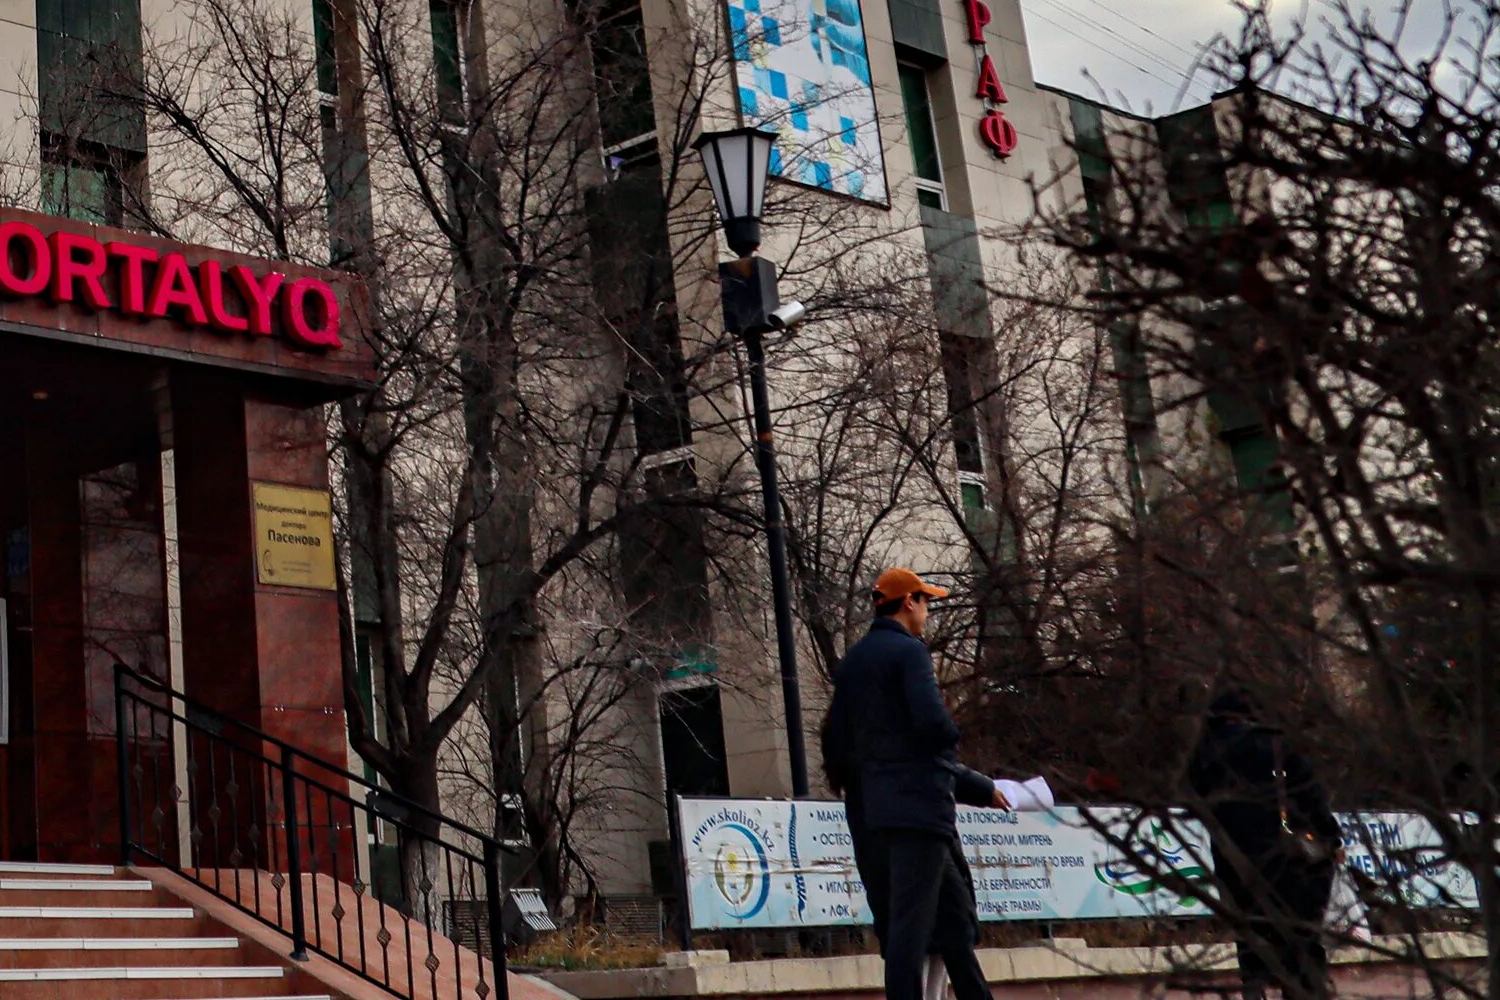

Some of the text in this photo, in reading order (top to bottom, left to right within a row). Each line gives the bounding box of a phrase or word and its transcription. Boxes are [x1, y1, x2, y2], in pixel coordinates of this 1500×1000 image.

[267, 529, 321, 547] Пасенова
[973, 812, 1019, 825] ПОЯСНИЦЕ
[691, 807, 775, 852] www.skolioz.kz
[1018, 834, 1053, 846] МИГРЕНЬ
[1060, 856, 1085, 867] ВРЕМЯ
[990, 878, 1052, 890] БЕРЕМЕННОСТИ
[1009, 900, 1042, 912] ТРАВМЫ
[829, 908, 850, 917] ЛФК
